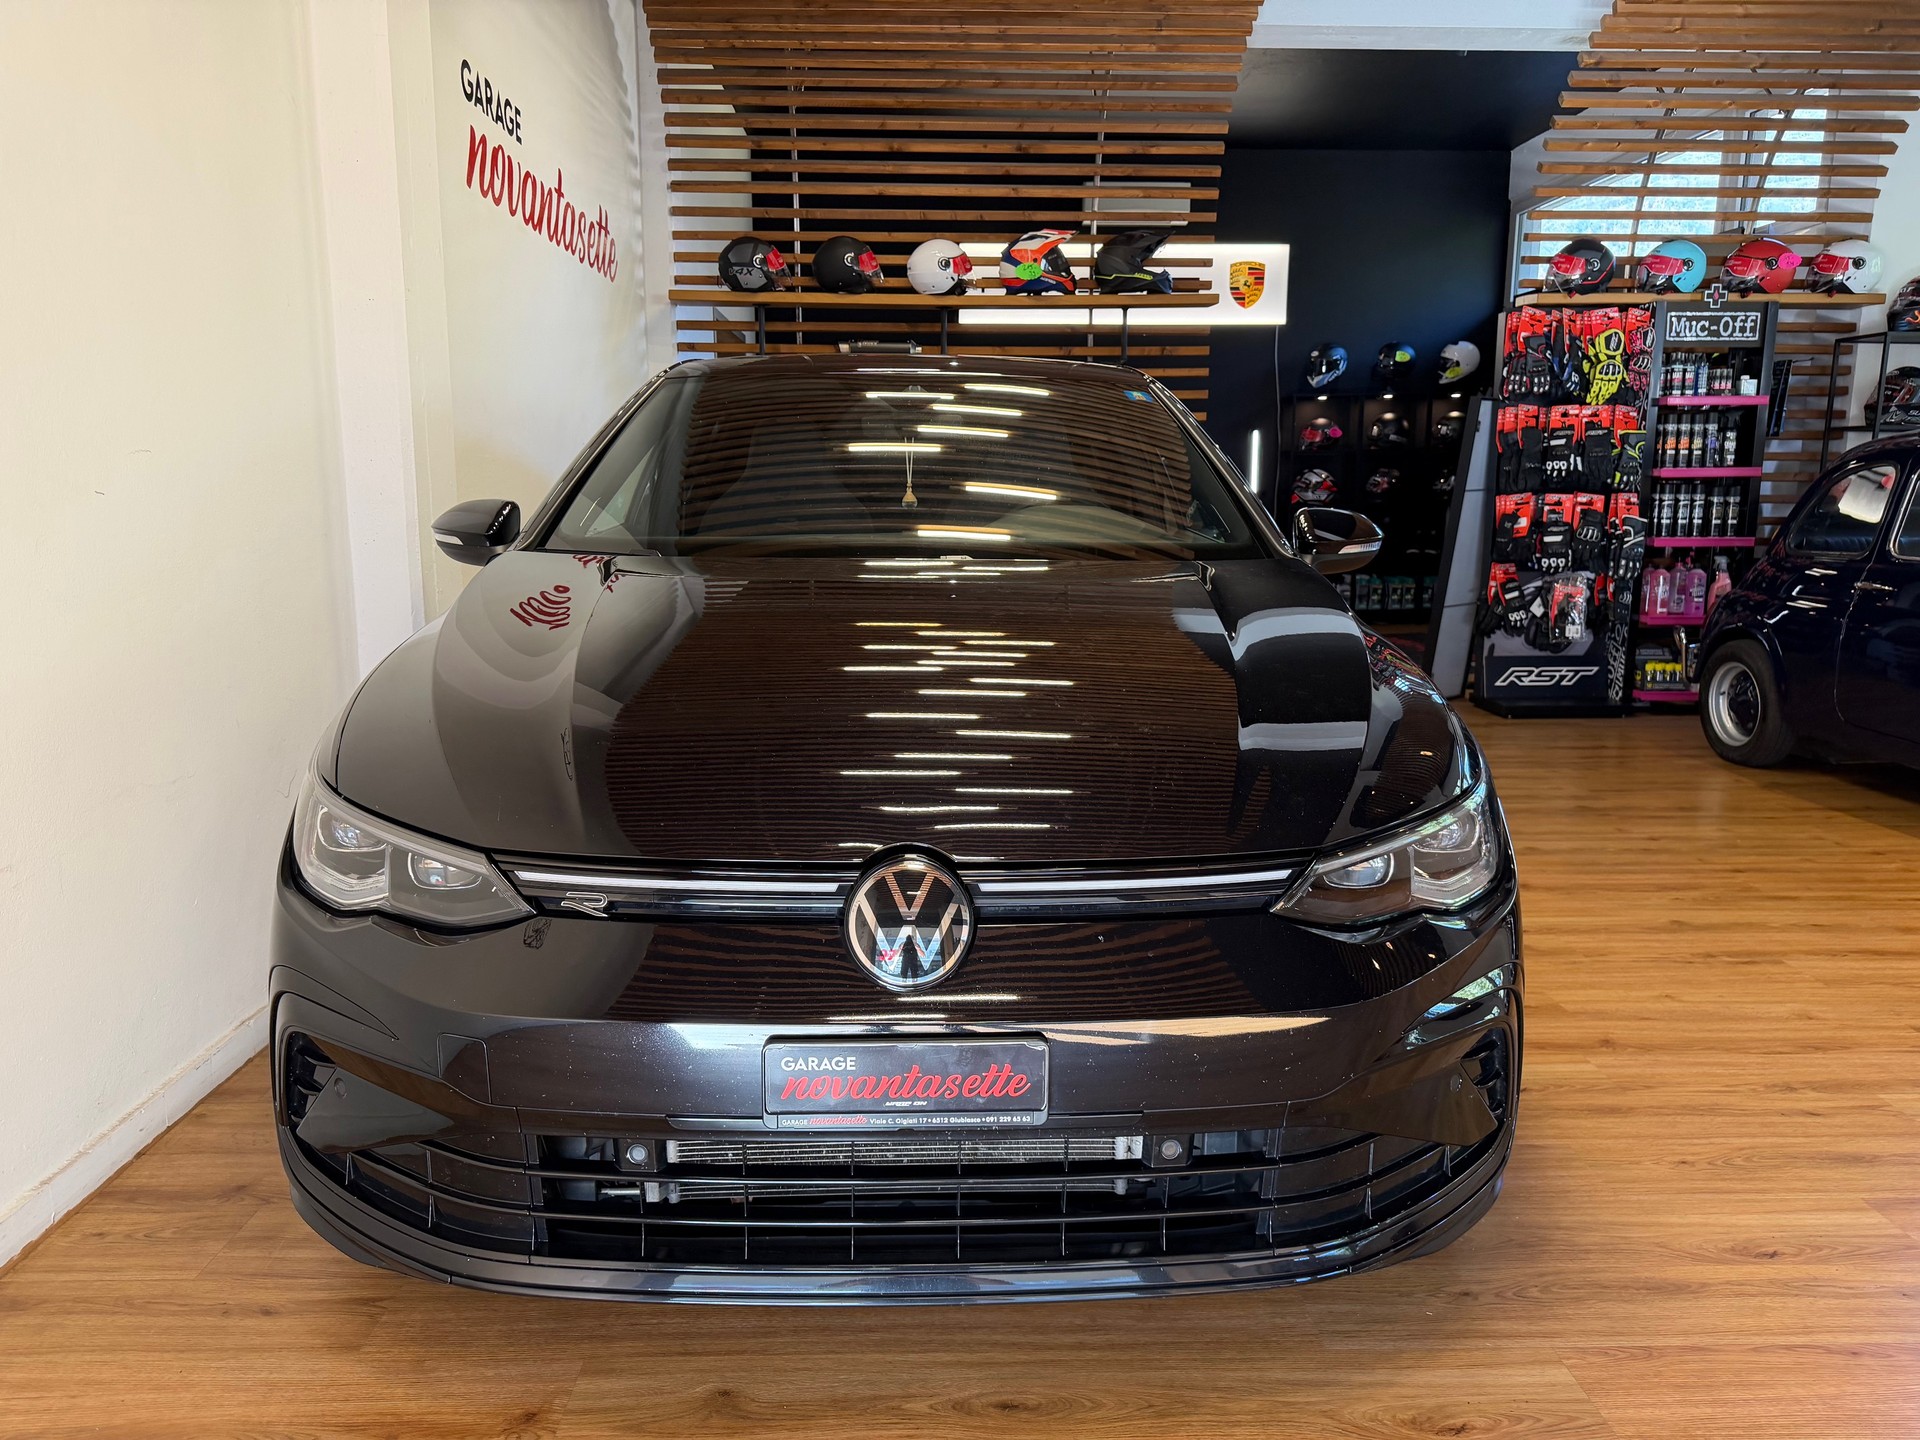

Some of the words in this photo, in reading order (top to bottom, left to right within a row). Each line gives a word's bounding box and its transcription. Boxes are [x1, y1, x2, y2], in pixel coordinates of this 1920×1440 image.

[460, 59, 523, 146] GARAGE
[466, 124, 619, 283] novantasette
[1670, 315, 1757, 338] Muc-Off
[1494, 666, 1600, 686] RST
[780, 1056, 857, 1071] GARAGE
[780, 1062, 1033, 1100] novantasette
[809, 1114, 868, 1125] novantasette
